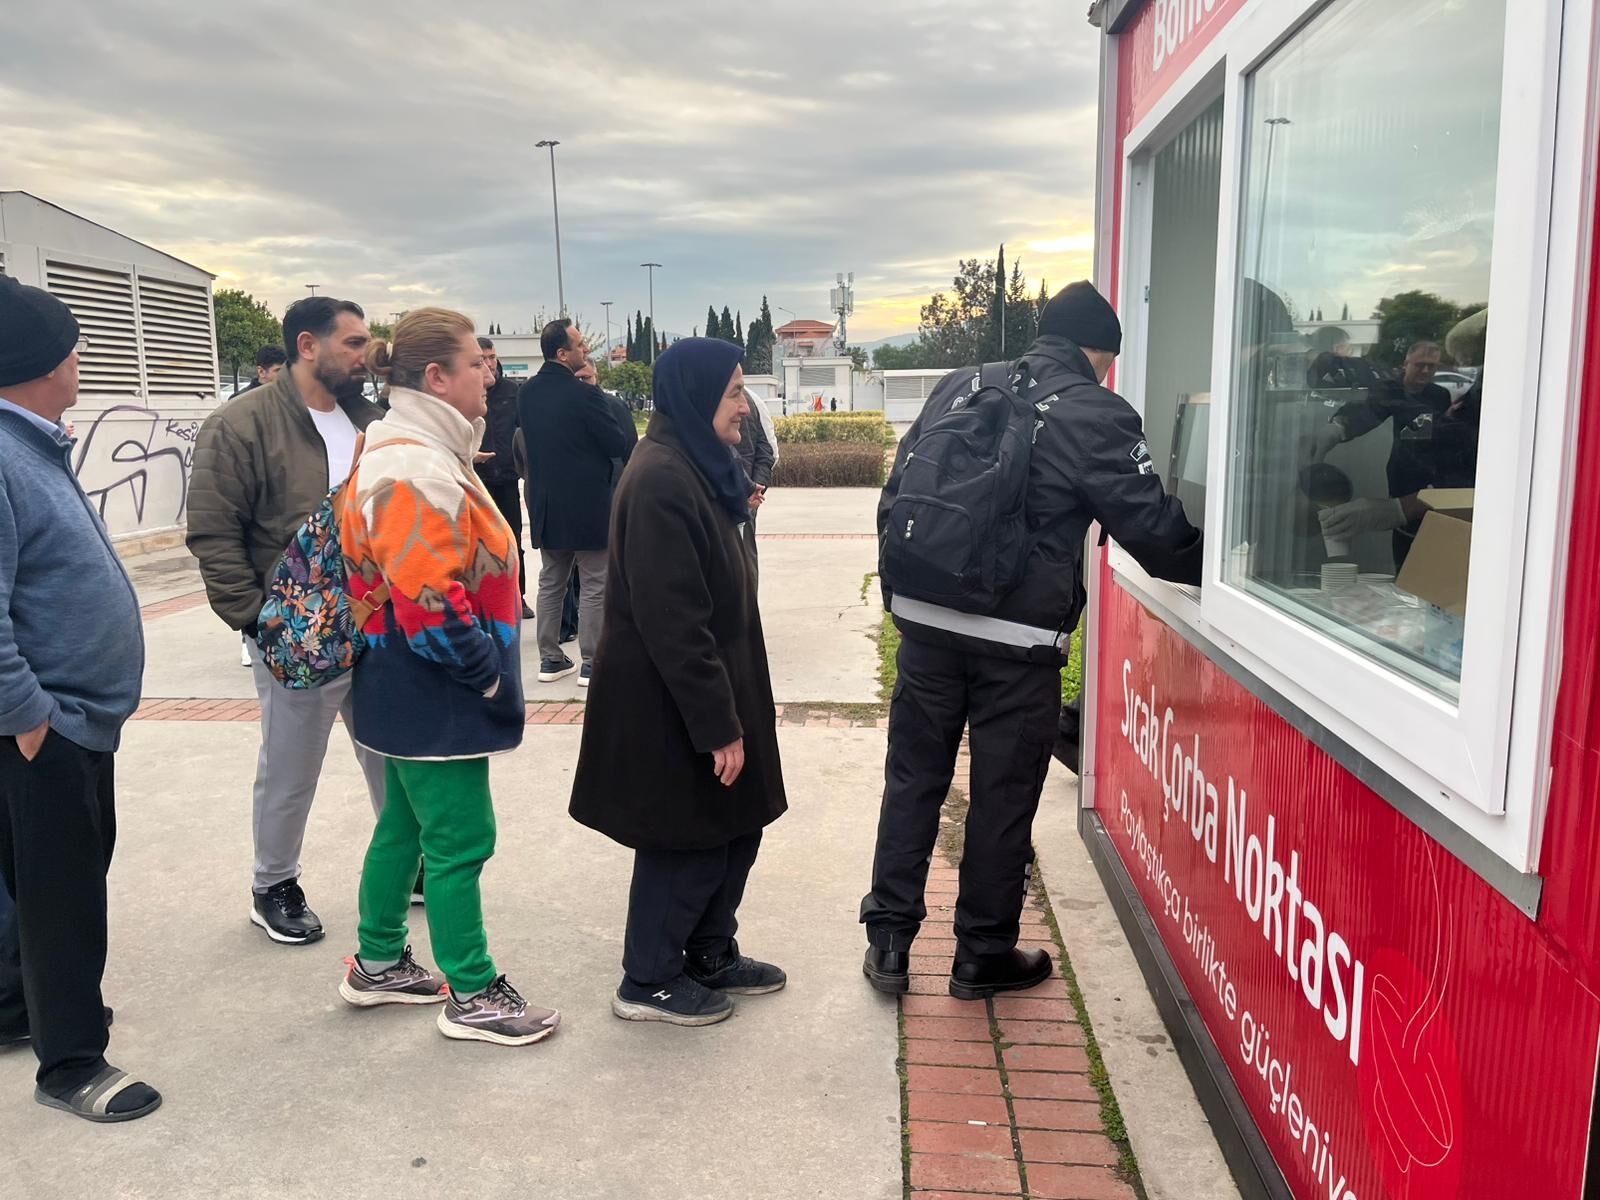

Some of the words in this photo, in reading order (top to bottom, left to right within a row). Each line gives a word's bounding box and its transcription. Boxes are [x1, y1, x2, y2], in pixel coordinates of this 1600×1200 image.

[1121, 658, 1159, 780] Sıcak
[1161, 707, 1219, 864] Çorba
[1224, 775, 1364, 1067] Noktası
[1183, 896, 1237, 1021] birlikte
